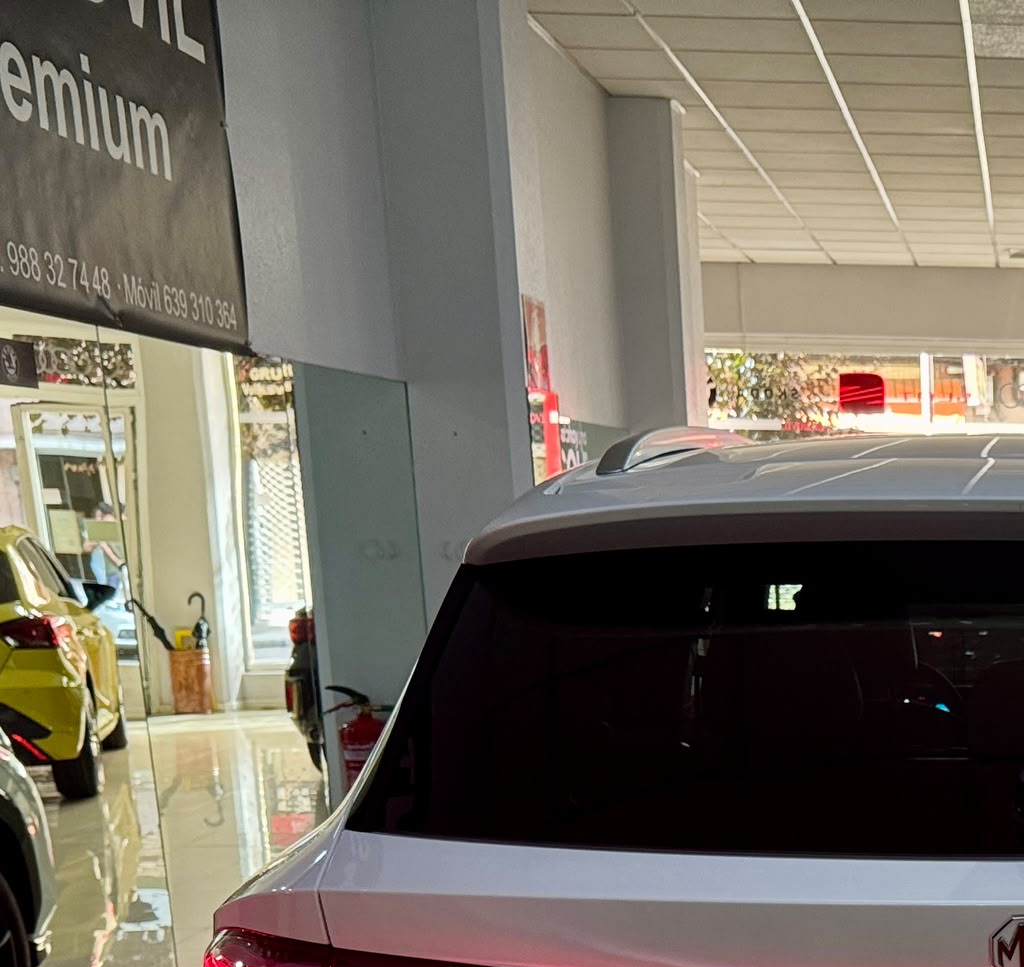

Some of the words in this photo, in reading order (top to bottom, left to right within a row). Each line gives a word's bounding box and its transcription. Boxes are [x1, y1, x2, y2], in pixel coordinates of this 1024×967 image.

[7, 241, 41, 282] 988
[44, 251, 67, 289] 32
[123, 273, 161, 312] Móvil
[163, 284, 188, 319] 639
[190, 292, 214, 325] 310
[215, 299, 238, 330] 364
